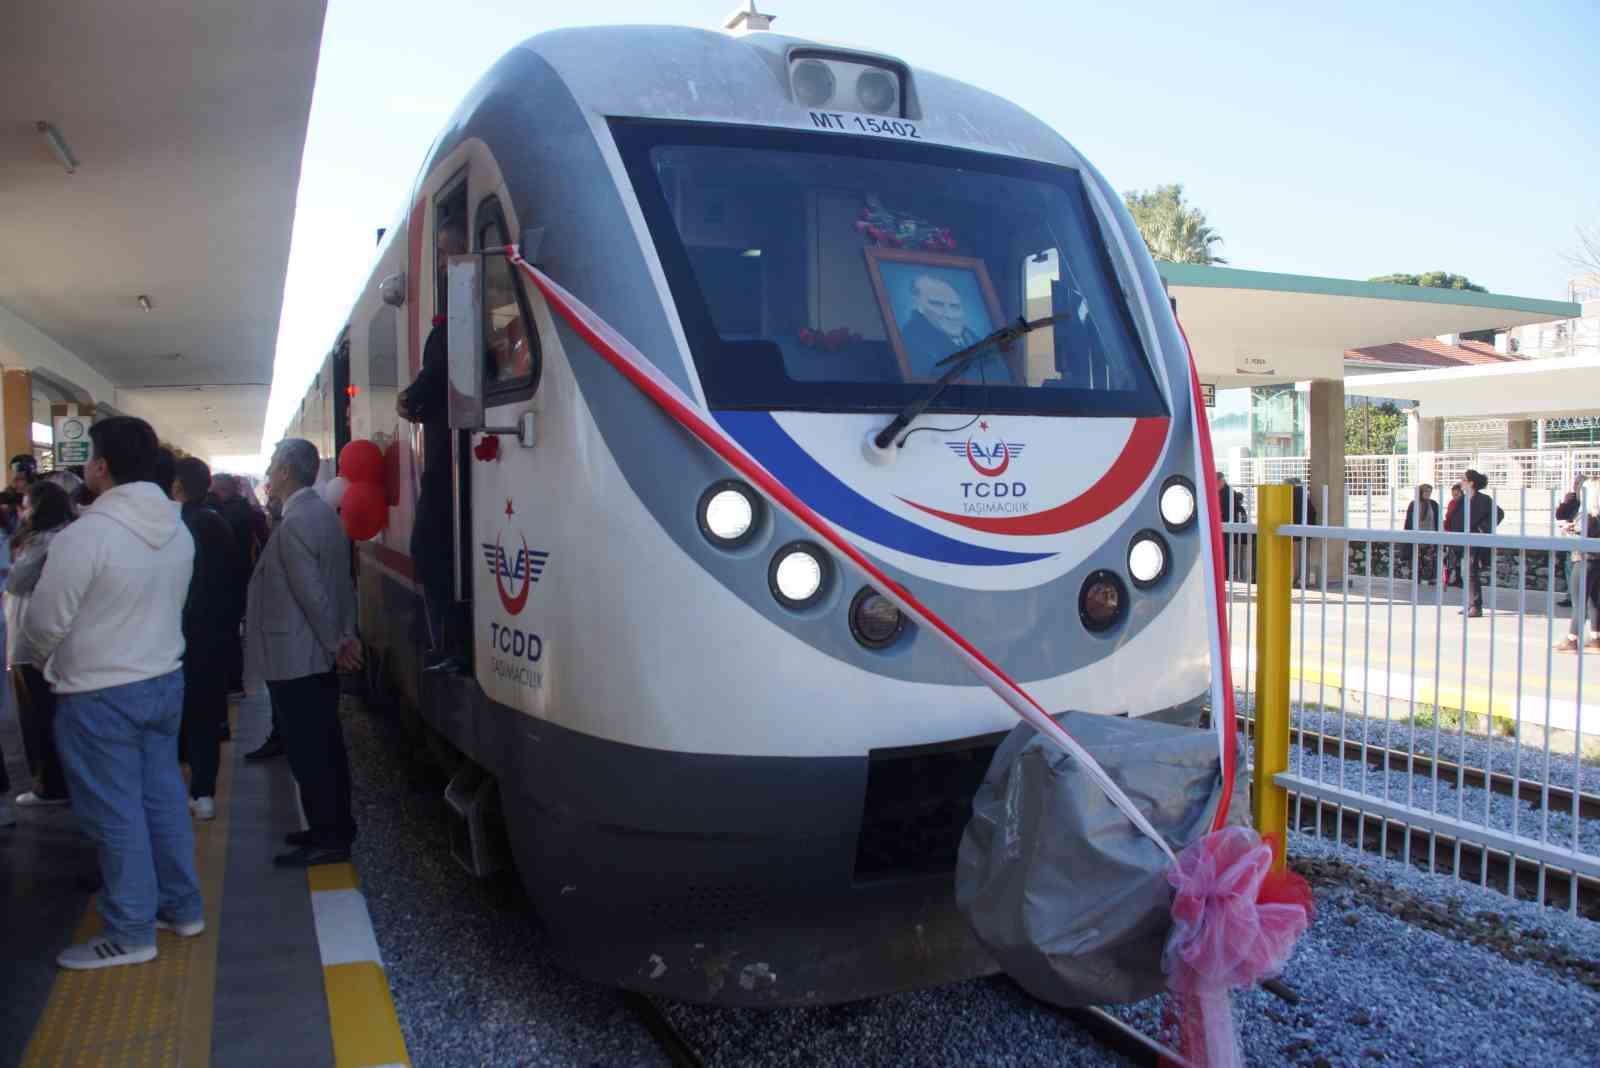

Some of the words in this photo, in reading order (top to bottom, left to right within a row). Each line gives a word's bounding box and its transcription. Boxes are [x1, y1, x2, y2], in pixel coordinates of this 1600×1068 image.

[808, 111, 846, 130] MT
[853, 117, 921, 139] 15402
[960, 482, 1027, 498] TCDD
[491, 622, 542, 662] TCDD
